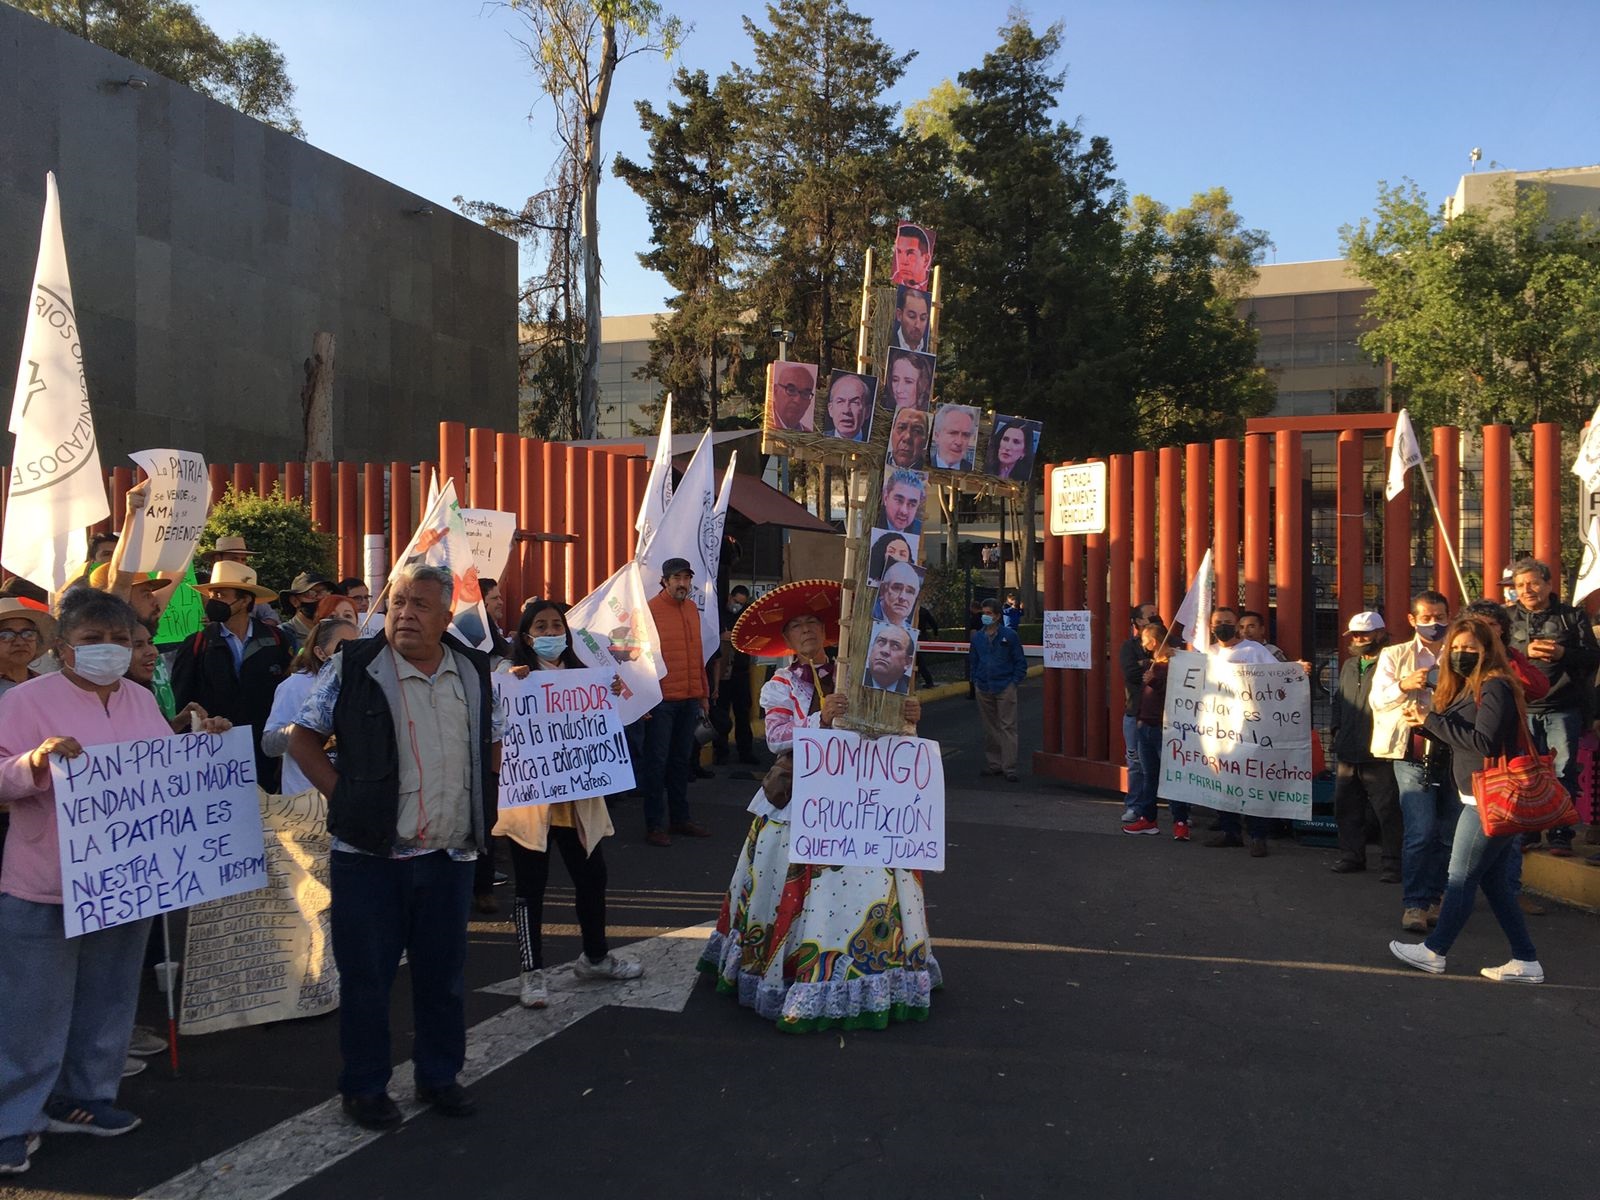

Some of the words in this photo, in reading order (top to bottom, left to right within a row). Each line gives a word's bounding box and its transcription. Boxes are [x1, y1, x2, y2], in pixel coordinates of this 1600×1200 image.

[169, 456, 203, 483] PATRIA
[145, 505, 173, 519] AMA
[154, 525, 202, 543] DEFIENDE
[1183, 668, 1206, 689] El
[515, 694, 538, 716] un
[1243, 710, 1261, 723] es
[1272, 710, 1301, 727] que
[528, 719, 543, 745] la
[1173, 720, 1244, 744] aprueben
[1252, 730, 1273, 748] la
[499, 752, 538, 786] ctrica
[537, 756, 550, 776] a
[799, 736, 931, 790] DOMINGO
[1166, 738, 1241, 775] REFORMA
[62, 779, 145, 827] VENDAN
[151, 779, 165, 803] A
[168, 771, 191, 798] SU
[197, 759, 255, 792] MADRE
[858, 788, 881, 806] DE
[1166, 769, 1182, 782] LA
[1189, 773, 1222, 791] PATRIA
[1226, 785, 1244, 798] NO
[1248, 788, 1264, 800] SE
[1268, 790, 1310, 804] VENDE
[802, 793, 932, 835] CRUCIFIXIÓN
[69, 834, 102, 863] LA
[104, 806, 197, 852] PATRIA
[206, 800, 232, 825] ES
[795, 835, 858, 860] QUEMA
[864, 842, 880, 855] DE
[882, 836, 937, 865] JUDAS
[72, 853, 163, 902] NUESTRA
[173, 845, 187, 875] Y
[198, 833, 233, 862] SE
[75, 871, 204, 933] RESPETA
